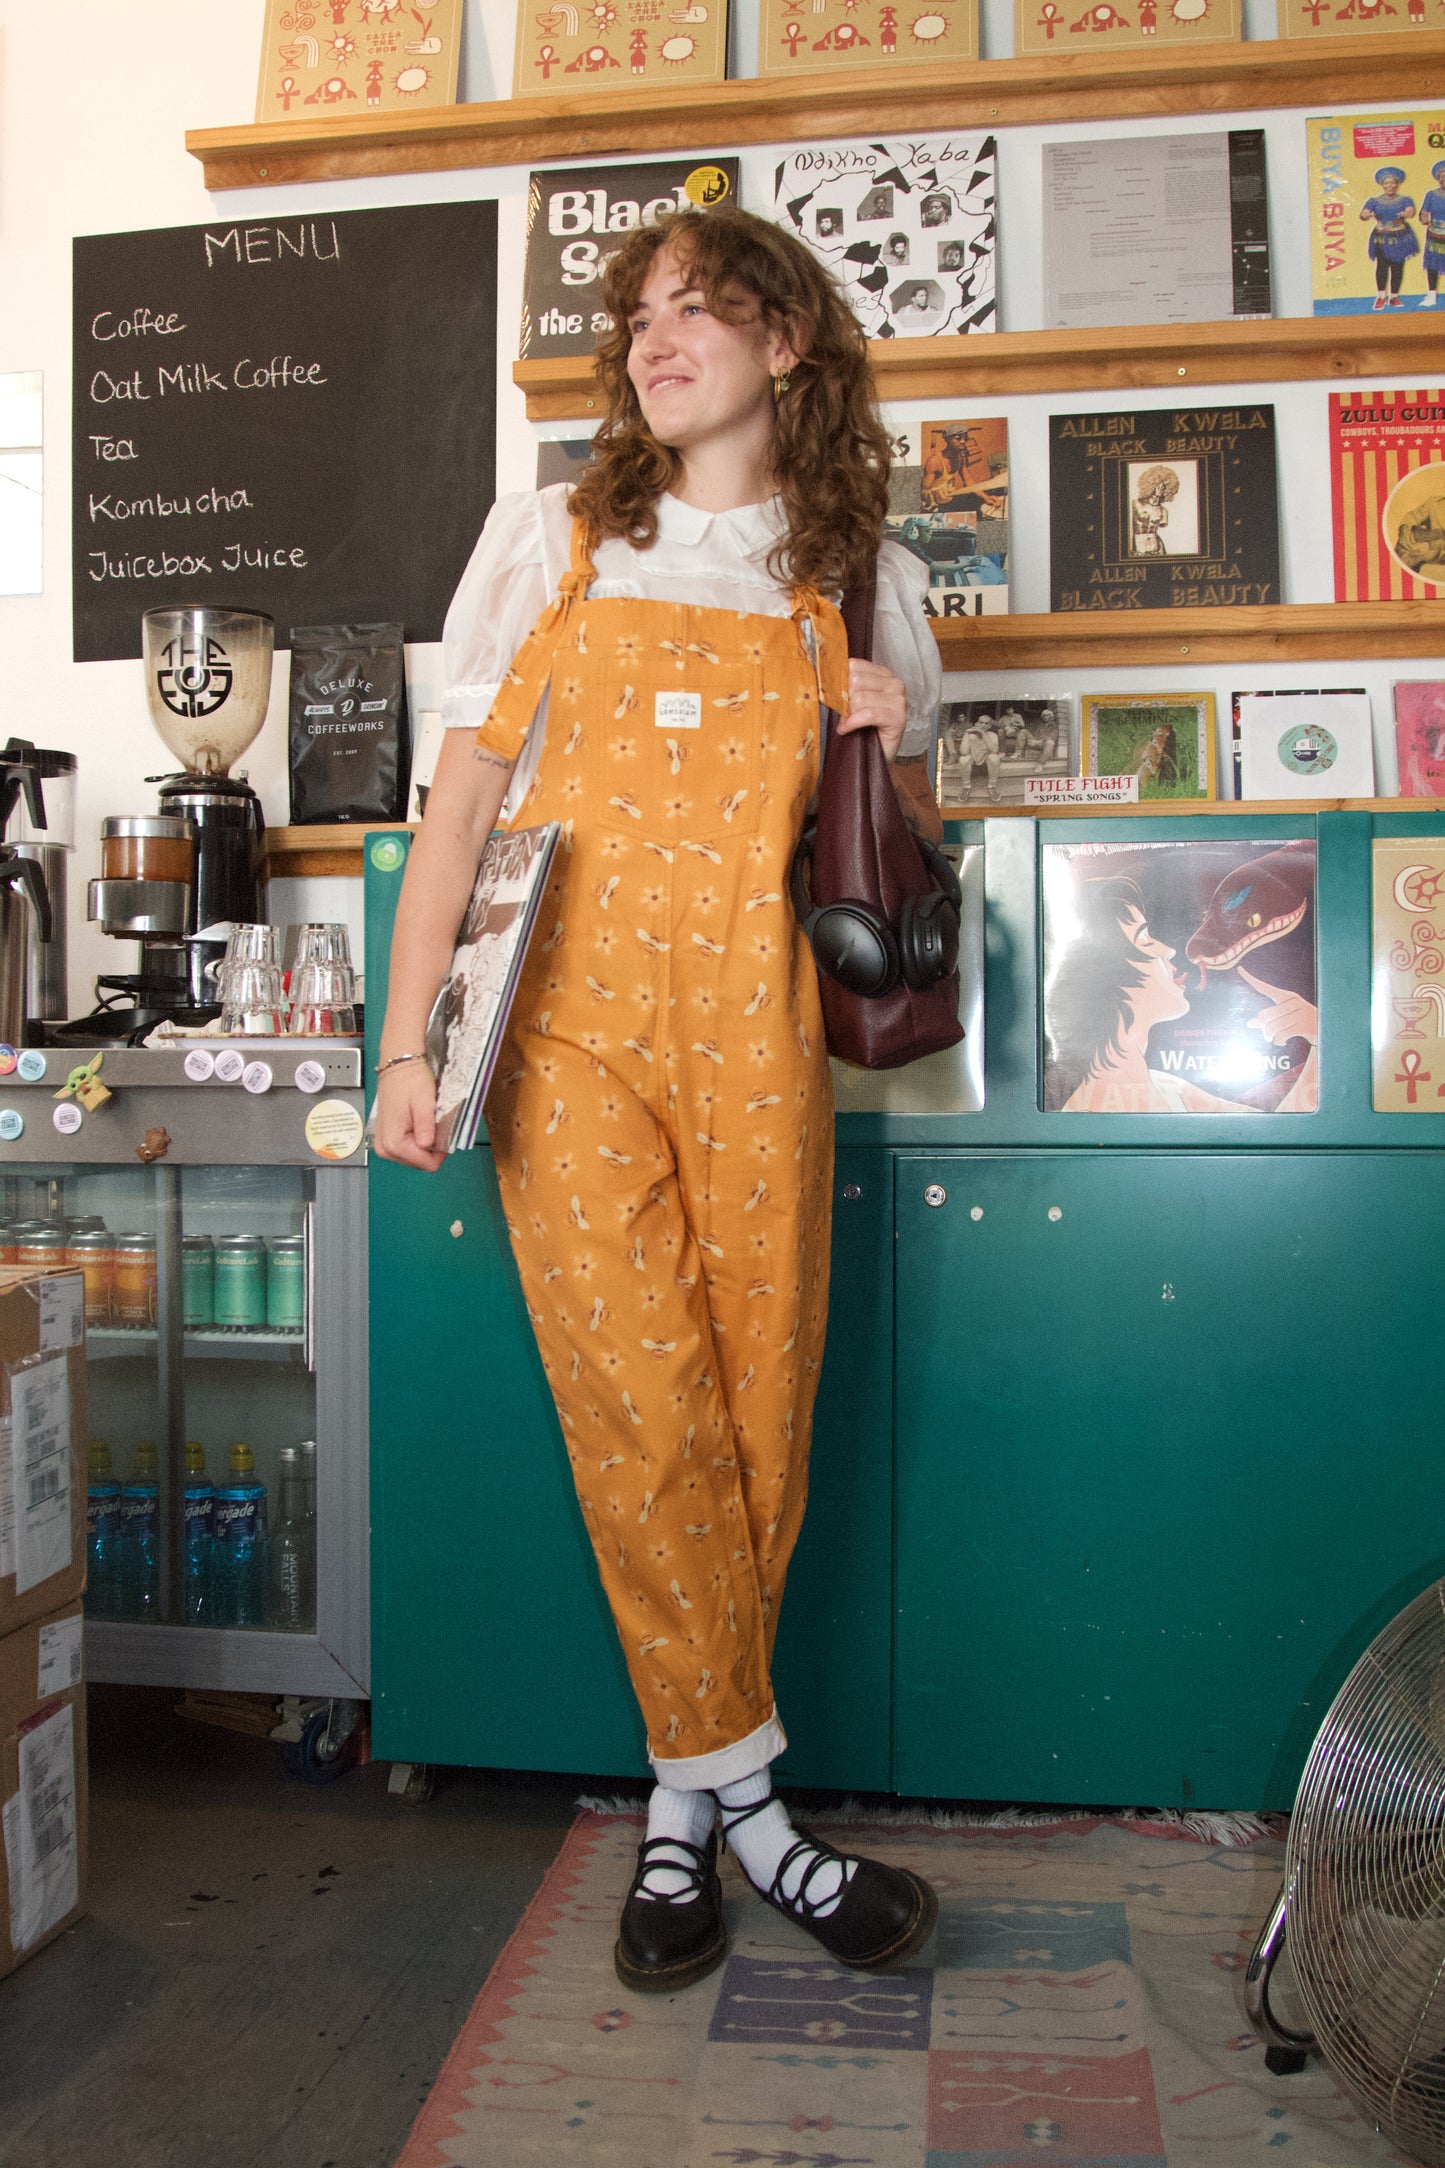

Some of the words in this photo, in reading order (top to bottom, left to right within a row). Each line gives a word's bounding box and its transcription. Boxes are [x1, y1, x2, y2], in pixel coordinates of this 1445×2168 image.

[1320, 127, 1344, 196] BUYA
[204, 221, 340, 268] MENU
[1323, 203, 1347, 272] BUYA
[91, 308, 188, 341] Coffee
[539, 308, 584, 337] the
[90, 370, 151, 404] Oat
[158, 362, 229, 397] Milk
[234, 355, 329, 389] Coffee
[1058, 415, 1136, 438] ALLEN
[1172, 410, 1268, 433] KWELA
[1340, 408, 1396, 424] ZULU
[88, 435, 139, 461] Tea
[1087, 439, 1147, 456] BLACK
[1166, 435, 1239, 453] BEAUTY
[88, 487, 254, 523] Kombucha
[88, 551, 213, 581] Juicebox
[221, 541, 309, 572] Juice
[1088, 566, 1147, 583] ALLEN
[1171, 563, 1242, 581] KWELA
[1059, 586, 1143, 611] BLACK
[1171, 583, 1271, 607] BEAUTY
[319, 678, 374, 696] DELUXE
[307, 721, 385, 735] COFFEEWORKS
[1027, 778, 1077, 792] TITLE
[1081, 777, 1134, 790] FIGHT
